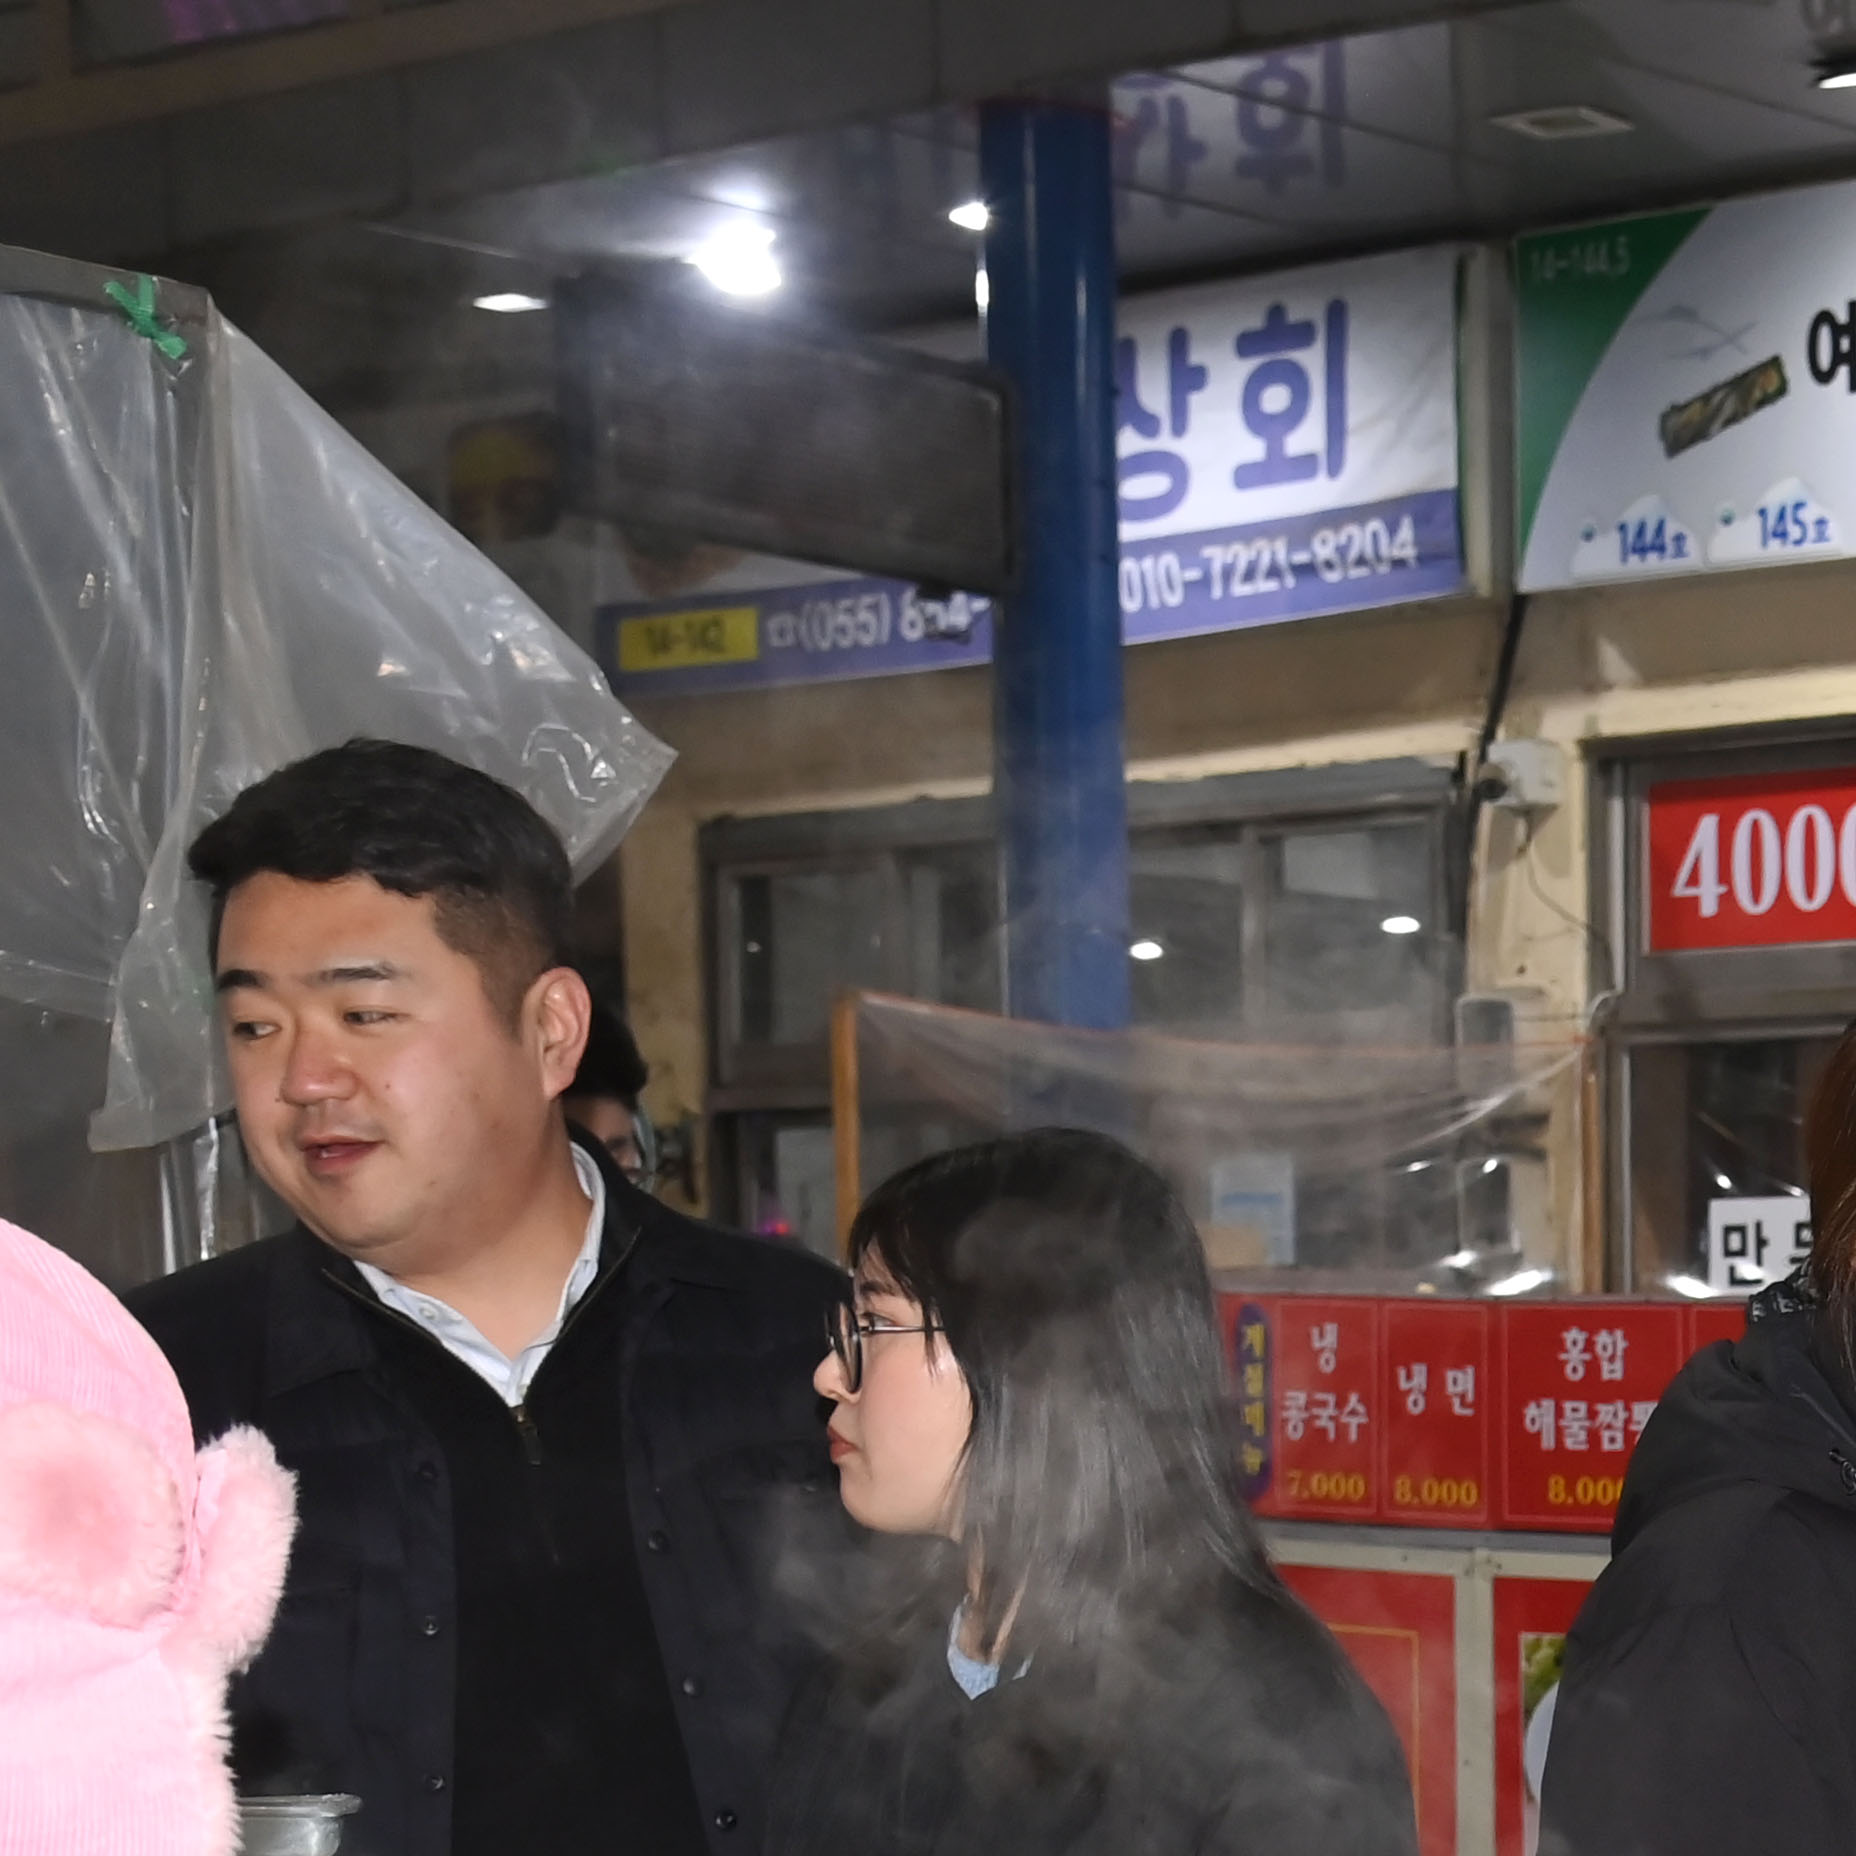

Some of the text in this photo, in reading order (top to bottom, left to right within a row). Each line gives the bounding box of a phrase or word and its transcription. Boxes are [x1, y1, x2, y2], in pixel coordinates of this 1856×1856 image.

[1118, 515, 1418, 613] 010-7221-8204
[1310, 1321, 1340, 1374] 냉
[1557, 1326, 1629, 1382] 홍합
[1281, 1390, 1370, 1444] 콩국수
